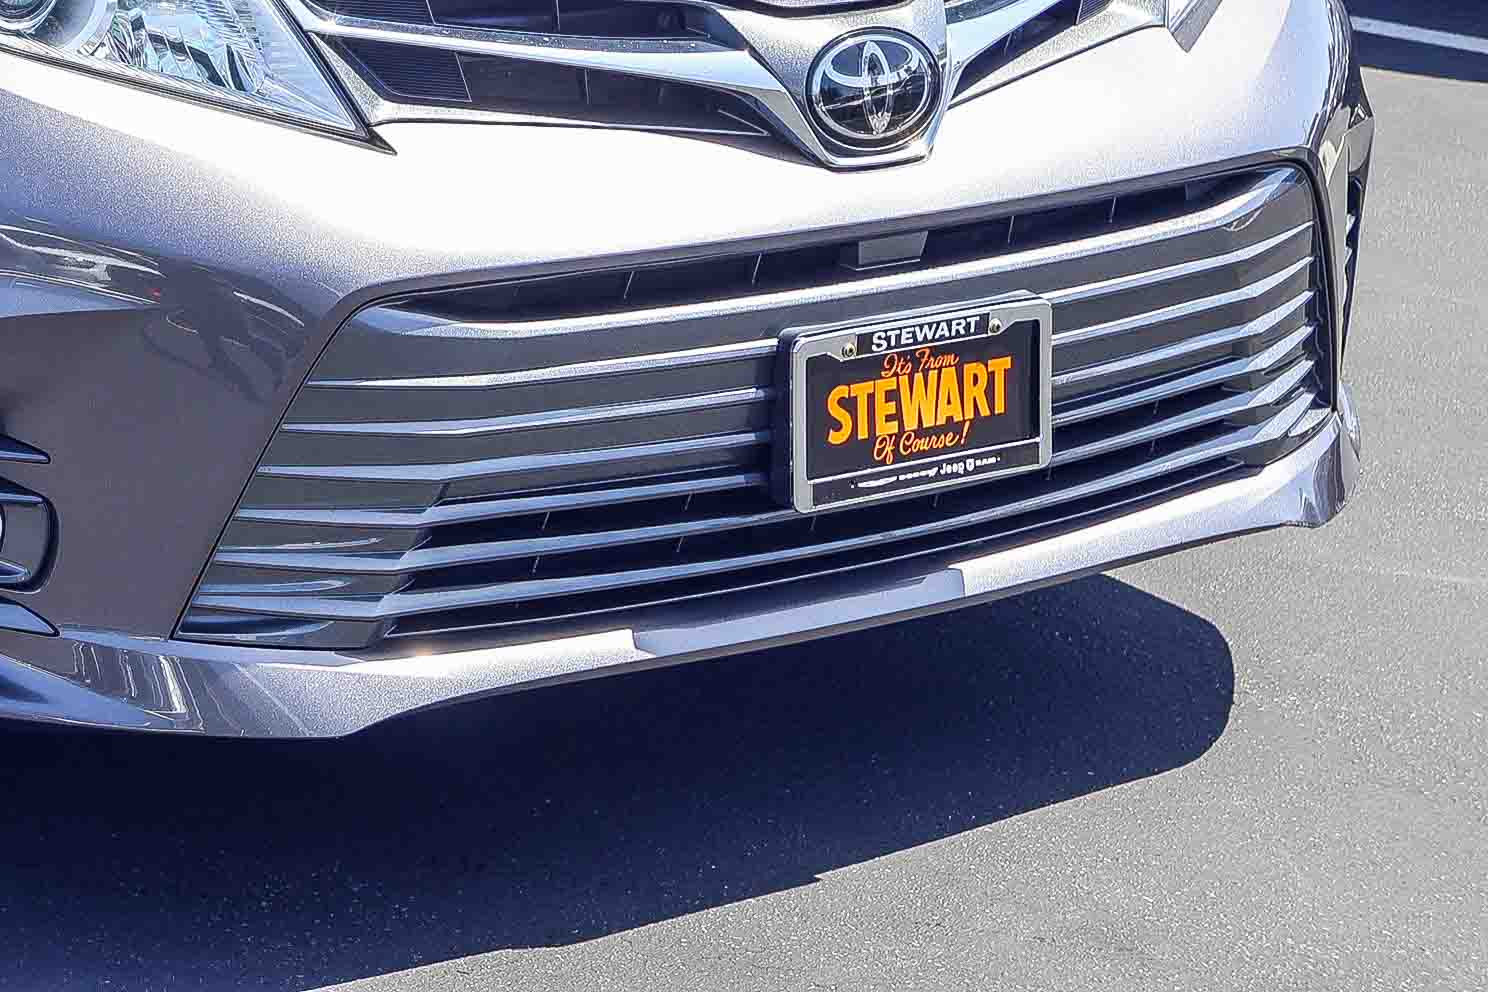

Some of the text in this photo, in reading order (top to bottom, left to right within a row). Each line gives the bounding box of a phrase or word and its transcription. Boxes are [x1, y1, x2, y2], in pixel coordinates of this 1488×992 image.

[871, 317, 980, 352] STEWART
[881, 347, 960, 378] It's From
[827, 356, 1012, 445] STEWART
[873, 420, 970, 465] Of Course!
[939, 462, 965, 475] Jeep
